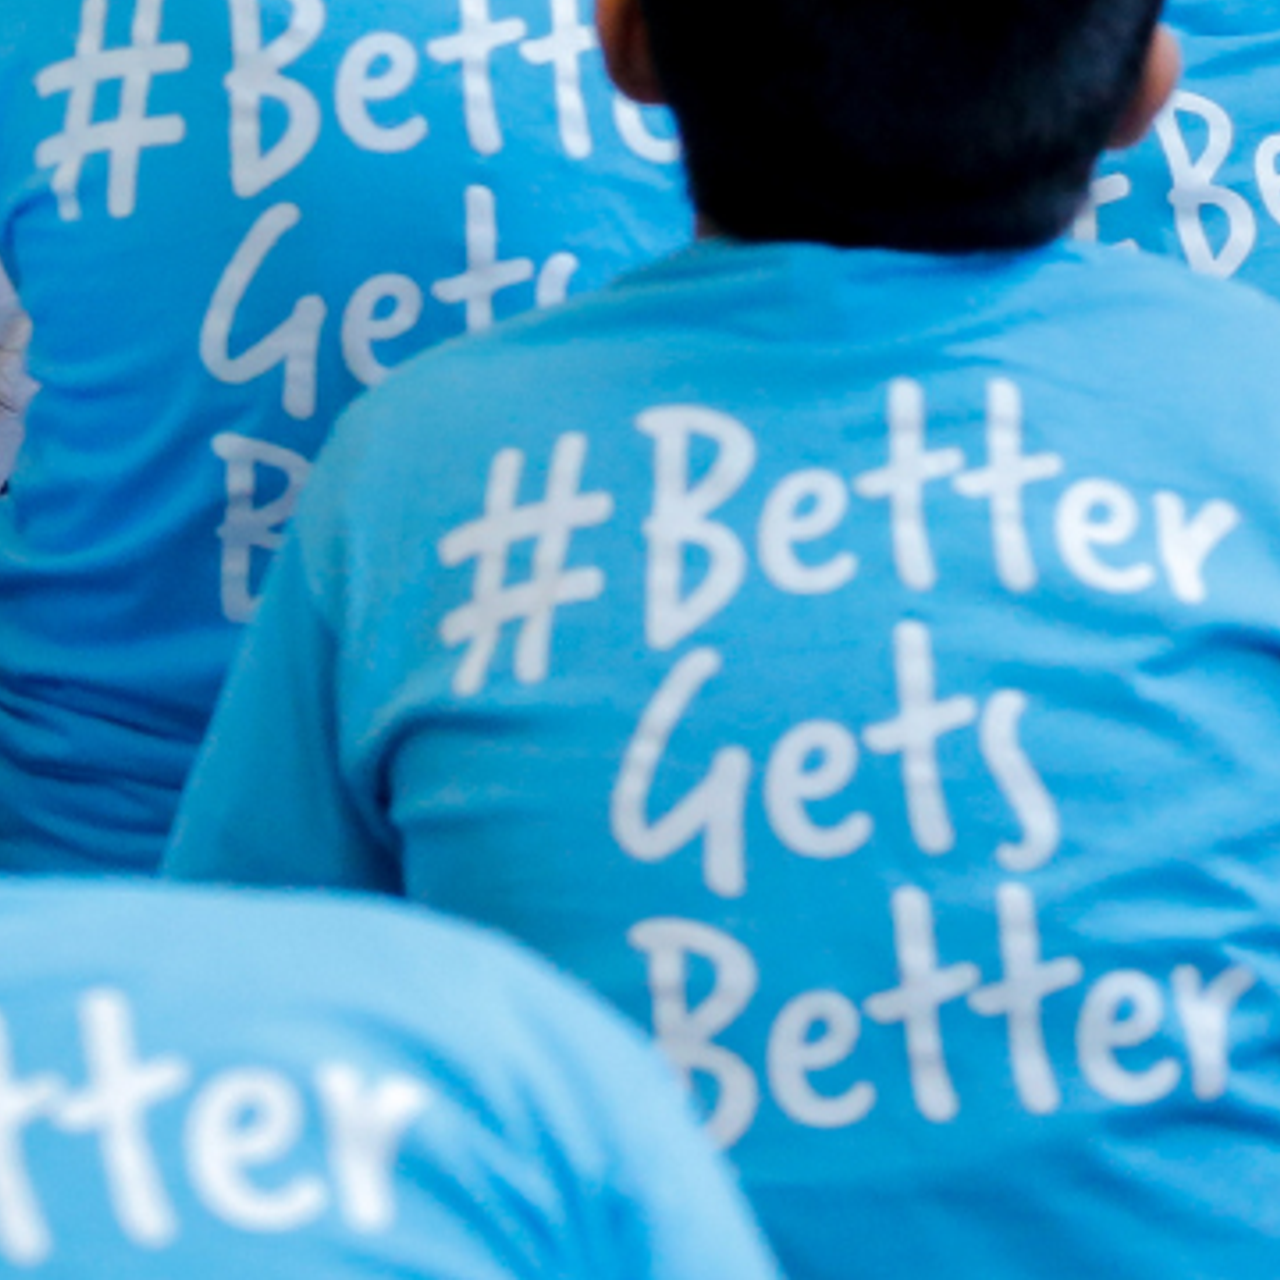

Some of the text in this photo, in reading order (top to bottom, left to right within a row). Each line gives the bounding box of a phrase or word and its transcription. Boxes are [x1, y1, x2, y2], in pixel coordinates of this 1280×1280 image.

[436, 375, 1242, 698] #Better
[609, 617, 1063, 900] Gets
[627, 880, 1257, 1152] Better
